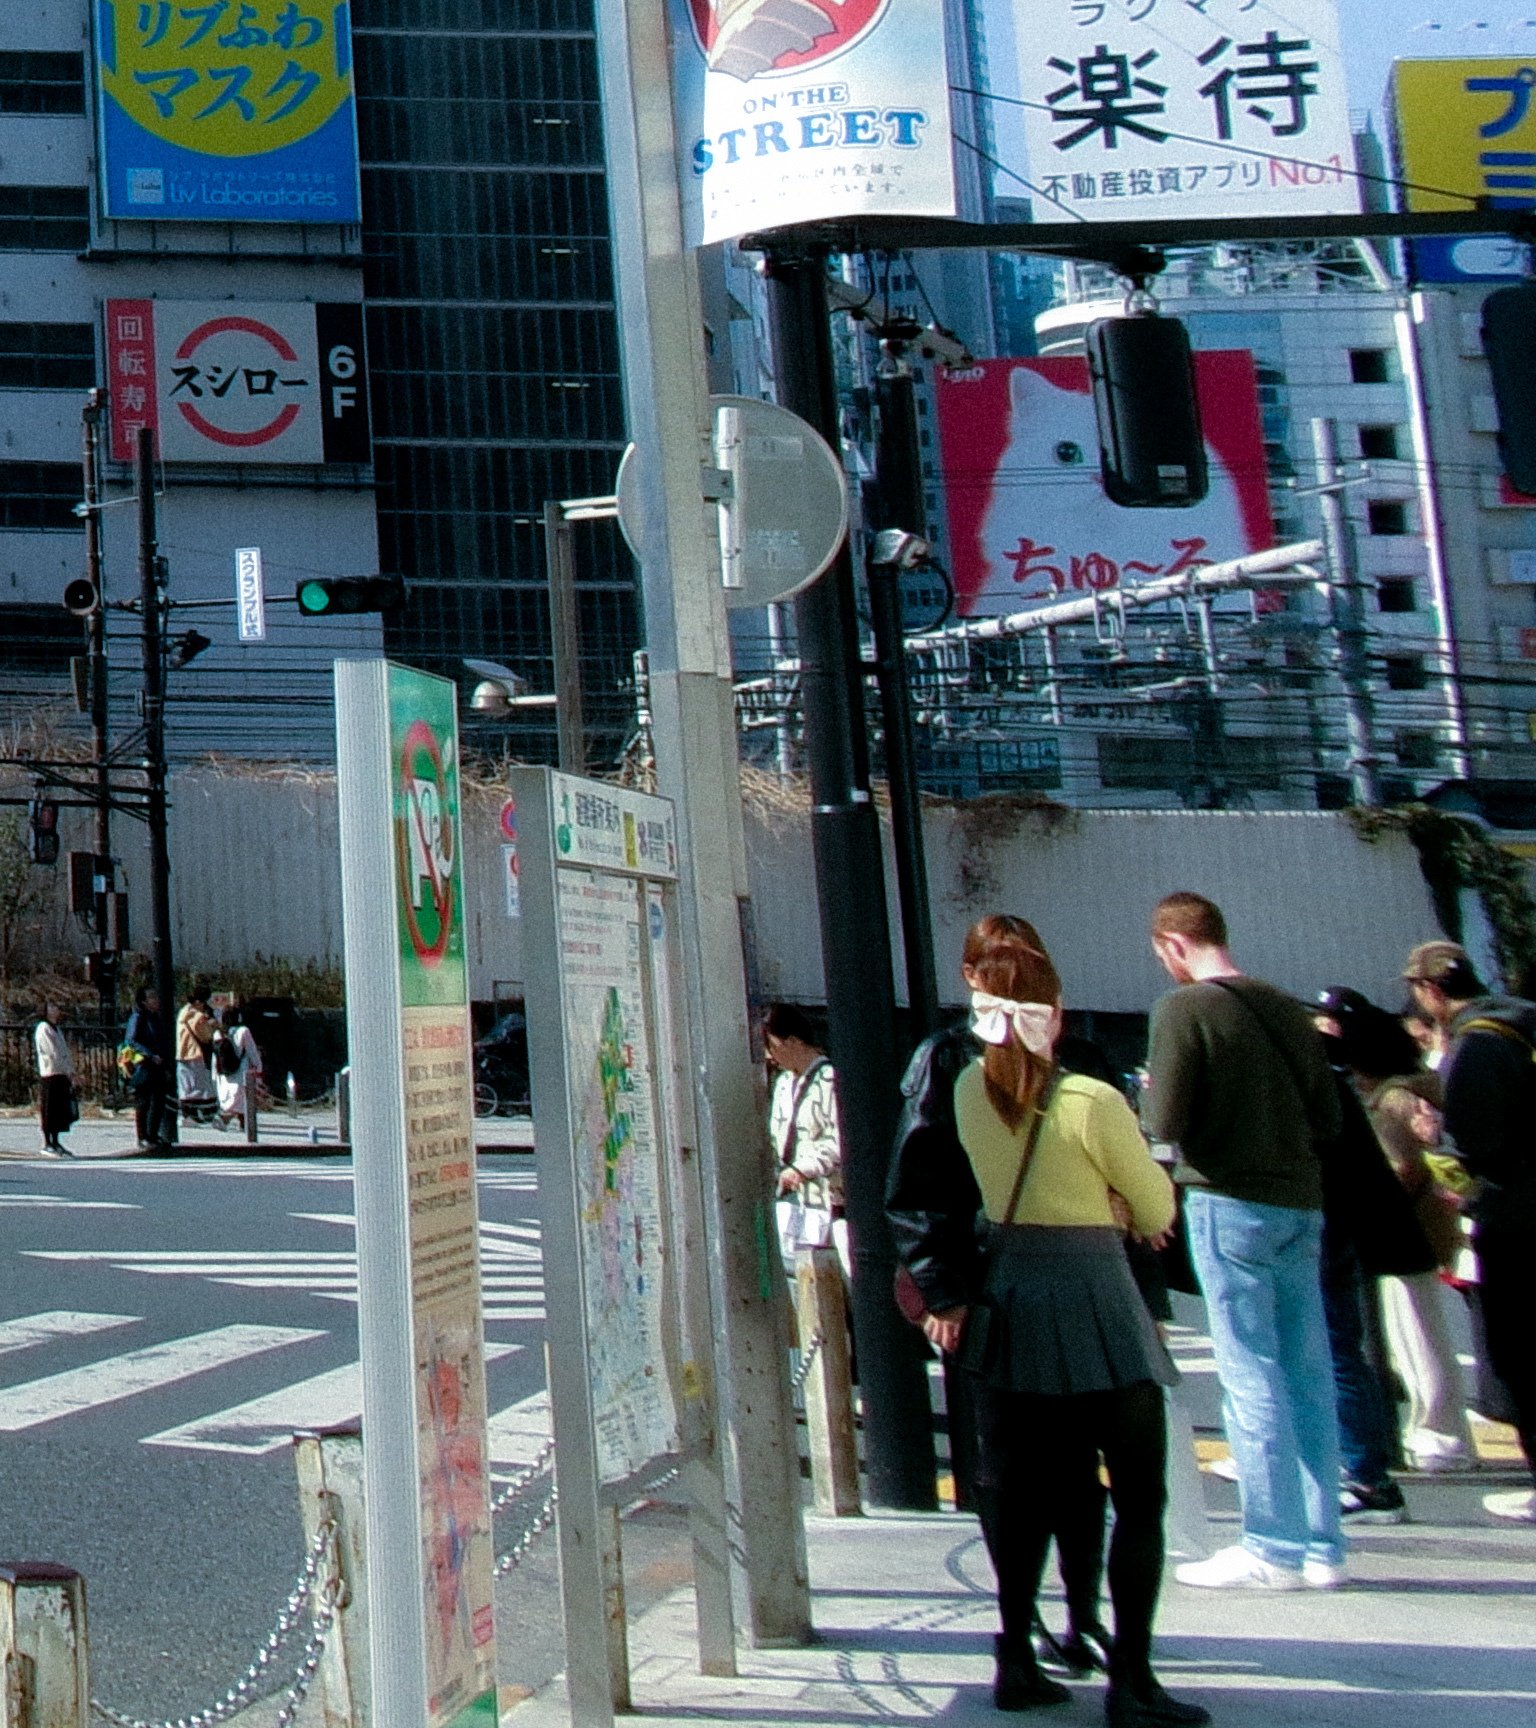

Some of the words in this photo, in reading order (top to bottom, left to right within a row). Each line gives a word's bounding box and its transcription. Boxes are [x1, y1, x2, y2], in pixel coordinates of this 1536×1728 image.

[133, 60, 322, 125] マスク
[743, 96, 778, 114] ON
[787, 84, 847, 108] THE
[1044, 30, 1320, 152] 楽待
[692, 110, 926, 175] STREET
[170, 183, 198, 204] Liv
[202, 181, 339, 207] Laboratories
[1041, 161, 1262, 202] 不動産投資アプリ
[1268, 154, 1344, 187] No.1
[168, 365, 309, 398] スシロー
